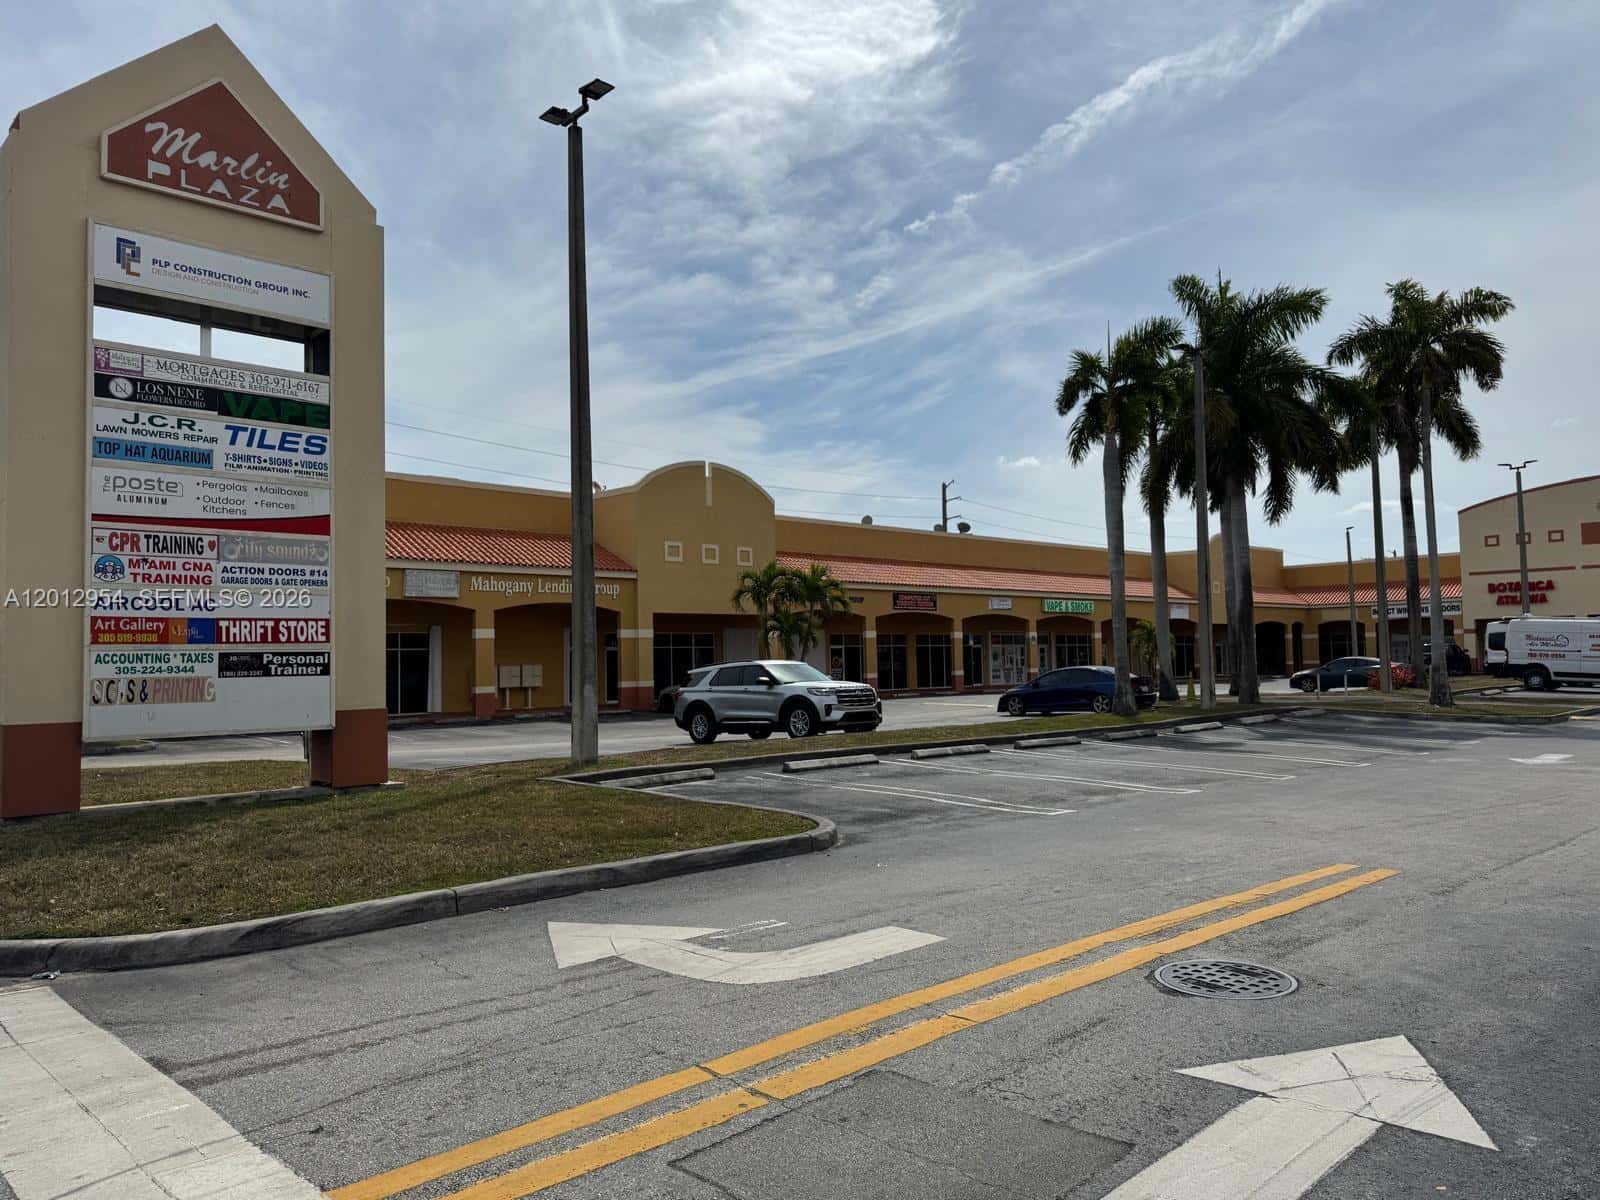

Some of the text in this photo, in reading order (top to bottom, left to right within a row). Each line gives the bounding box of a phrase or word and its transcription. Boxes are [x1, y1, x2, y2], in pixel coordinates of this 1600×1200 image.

[145, 121, 290, 190] Marlin
[147, 159, 290, 215] PLAZA
[152, 258, 170, 268] PLP
[173, 263, 252, 287] CONSTRUCTION
[291, 288, 311, 299] INC.
[156, 359, 245, 383] MORTGAGES
[223, 391, 330, 430] VAPE
[122, 413, 203, 433] J.C.R.
[96, 424, 218, 445] LAWN MOWERS REPAIR
[224, 424, 328, 456] TILES
[97, 441, 211, 465] TOP HAT AQUARIUM
[246, 465, 290, 474] ANIMATION
[294, 469, 328, 478] PRINTING
[268, 457, 293, 468] SIGNS
[300, 460, 328, 471] VIDEOS
[112, 476, 178, 493] poste
[202, 480, 309, 498] Pergolas Mailboxes
[117, 495, 167, 505] ALUMINUM
[202, 495, 295, 510] Outdoor Fences
[202, 505, 247, 516] Kitchens
[108, 532, 204, 556] CPR TRAINING
[182, 561, 213, 573] CNA
[221, 566, 265, 575] ACTION
[268, 567, 306, 577] DOORS
[130, 573, 213, 585] TRAINING
[221, 576, 249, 585] GARAGE
[250, 577, 273, 586] DOORS
[299, 579, 329, 587] OPENERS
[470, 575, 534, 596] Mahogany
[538, 578, 572, 593] Lendi
[594, 584, 620, 598] roup
[1046, 600, 1063, 611] VAPE
[1070, 602, 1093, 612] SMOKE
[94, 619, 116, 631] Art
[120, 619, 167, 634] Gallery
[219, 620, 274, 642] THRIFT
[279, 620, 327, 642] STORE
[95, 653, 214, 664] ACCOUNTING TAXES
[263, 653, 329, 664] Personal
[115, 665, 195, 674] 305-224-9344
[268, 664, 323, 675] Trainer
[140, 679, 148, 703] &
